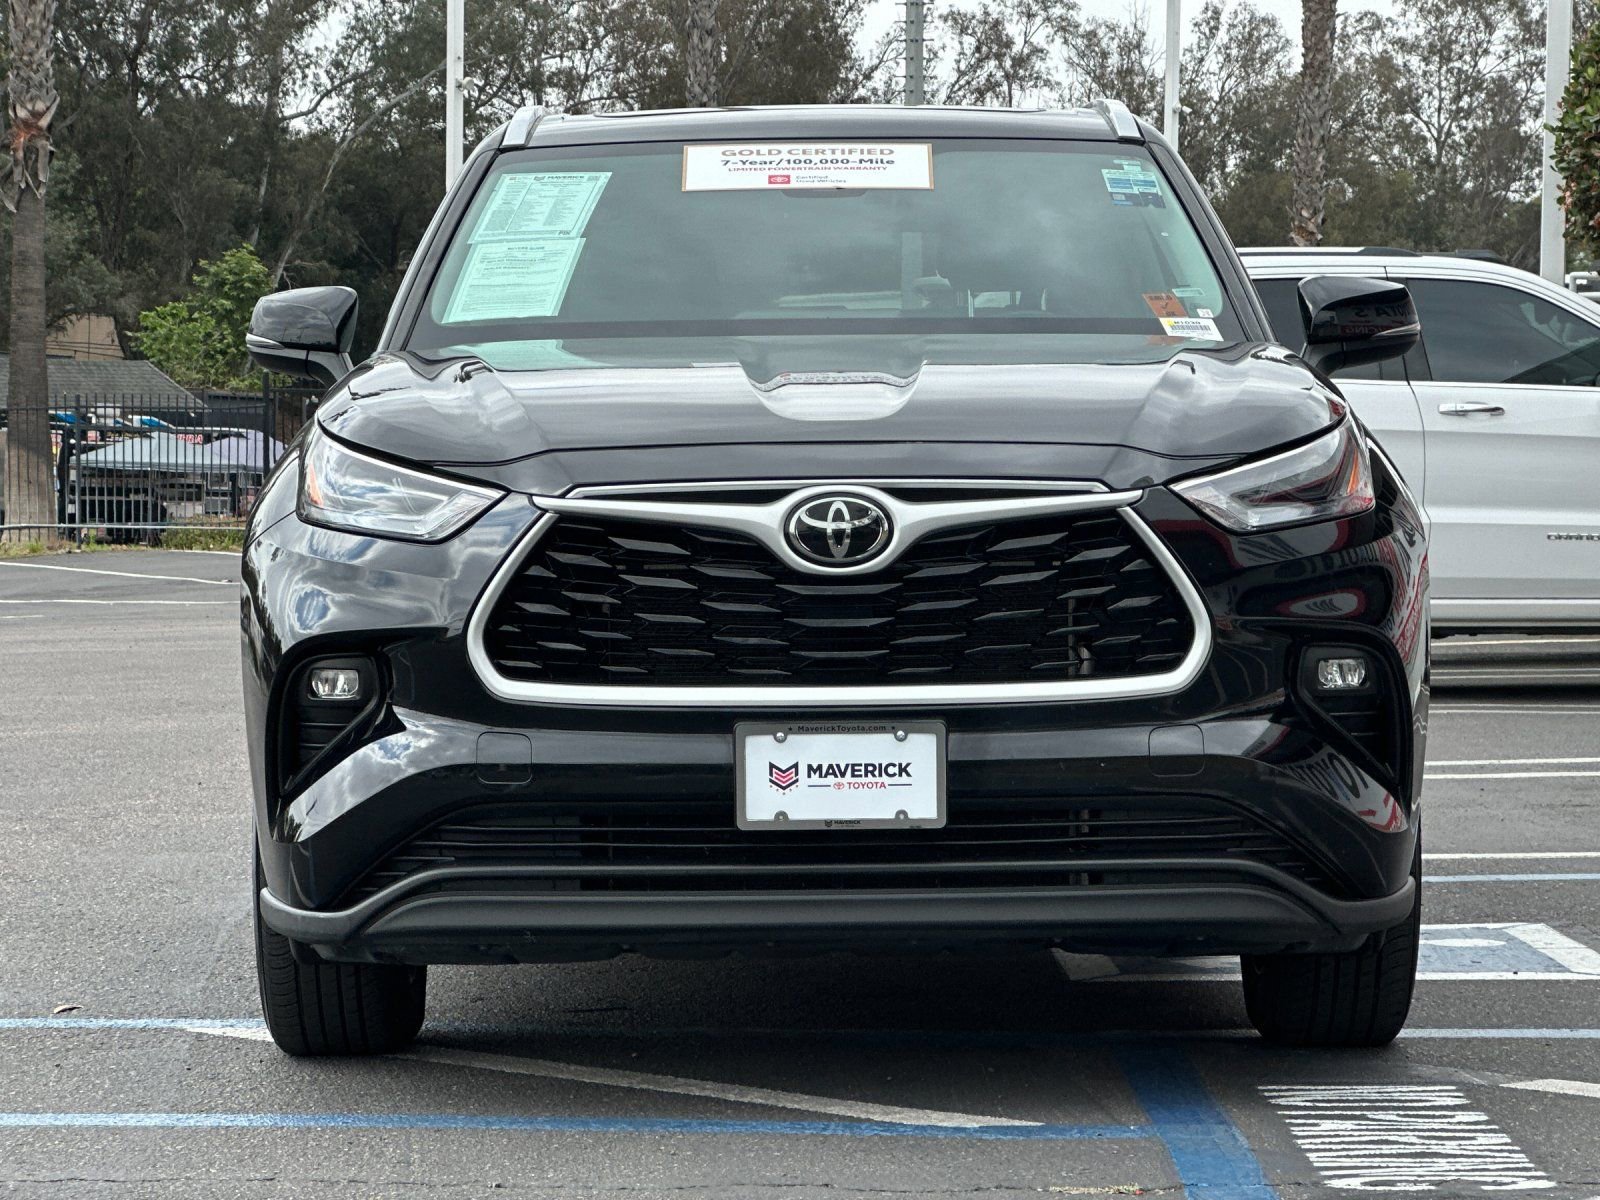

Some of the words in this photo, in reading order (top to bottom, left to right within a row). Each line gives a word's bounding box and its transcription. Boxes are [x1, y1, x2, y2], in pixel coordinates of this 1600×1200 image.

[721, 148, 783, 157] GOLD
[787, 148, 895, 156] CERTIFIED
[720, 158, 896, 167] 7-Year/100,000-Mile
[797, 724, 887, 733] MaverickToyota.com
[806, 762, 913, 779] MAVERICK
[846, 781, 887, 790] TOYOTA
[1276, 1110, 1558, 1191] PARKING
